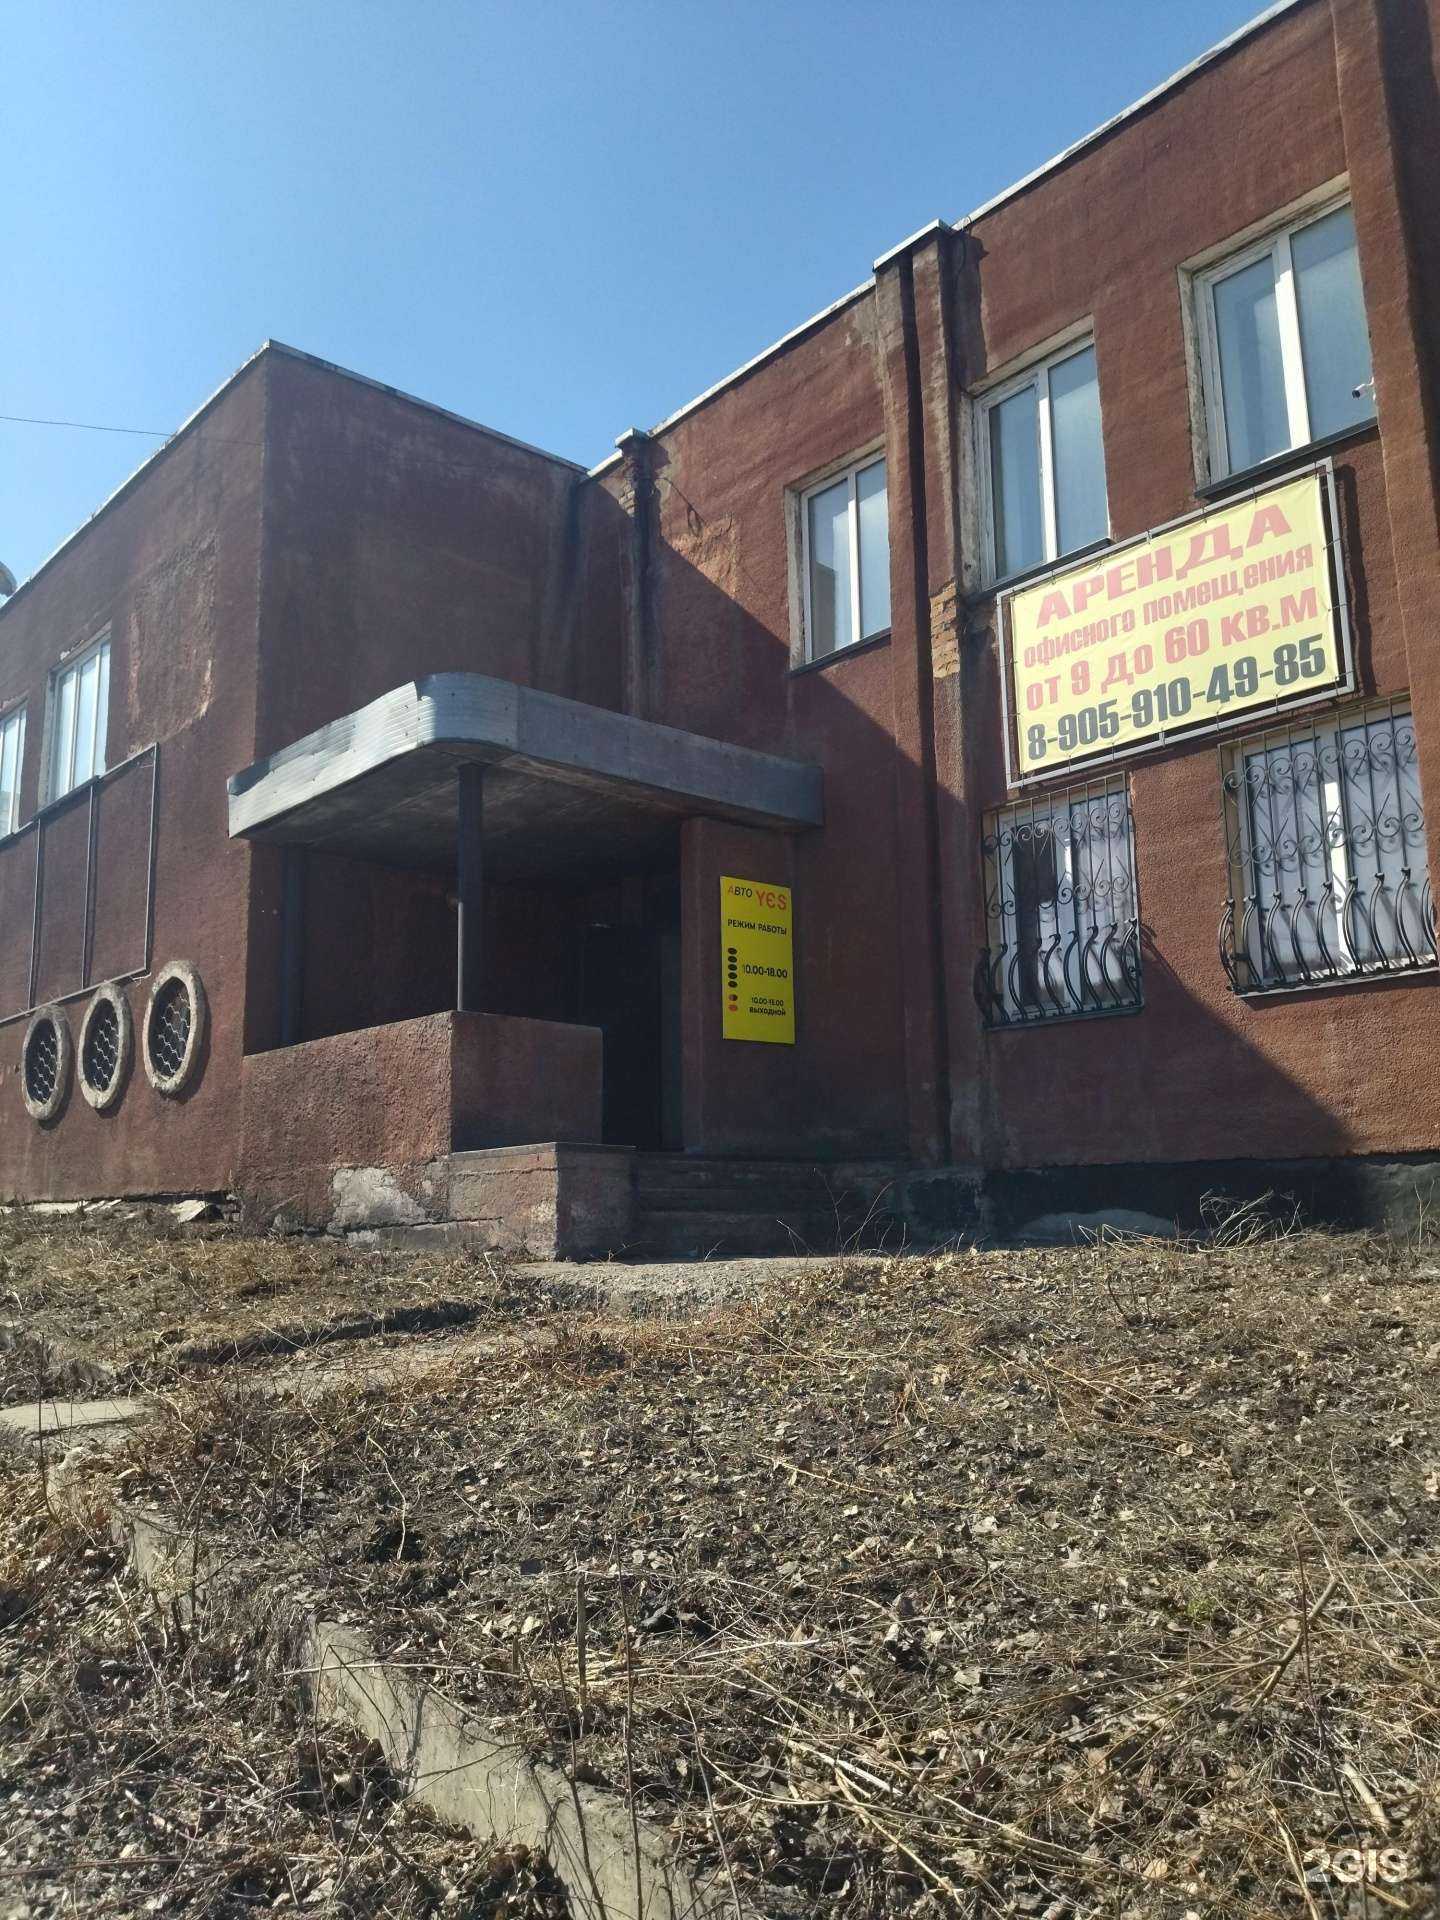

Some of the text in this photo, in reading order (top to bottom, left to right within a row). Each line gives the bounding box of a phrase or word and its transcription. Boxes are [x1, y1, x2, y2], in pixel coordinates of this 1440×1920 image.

[1036, 504, 1292, 628] АРЕНДА
[1071, 660, 1090, 695] 9
[1164, 618, 1209, 664] 60
[1027, 633, 1326, 760] 8-905-910-49-85
[728, 886, 753, 898] АВТО
[727, 919, 787, 935] РЕЖИМ РАБОТЫ
[742, 964, 788, 978] 10.00-18.00
